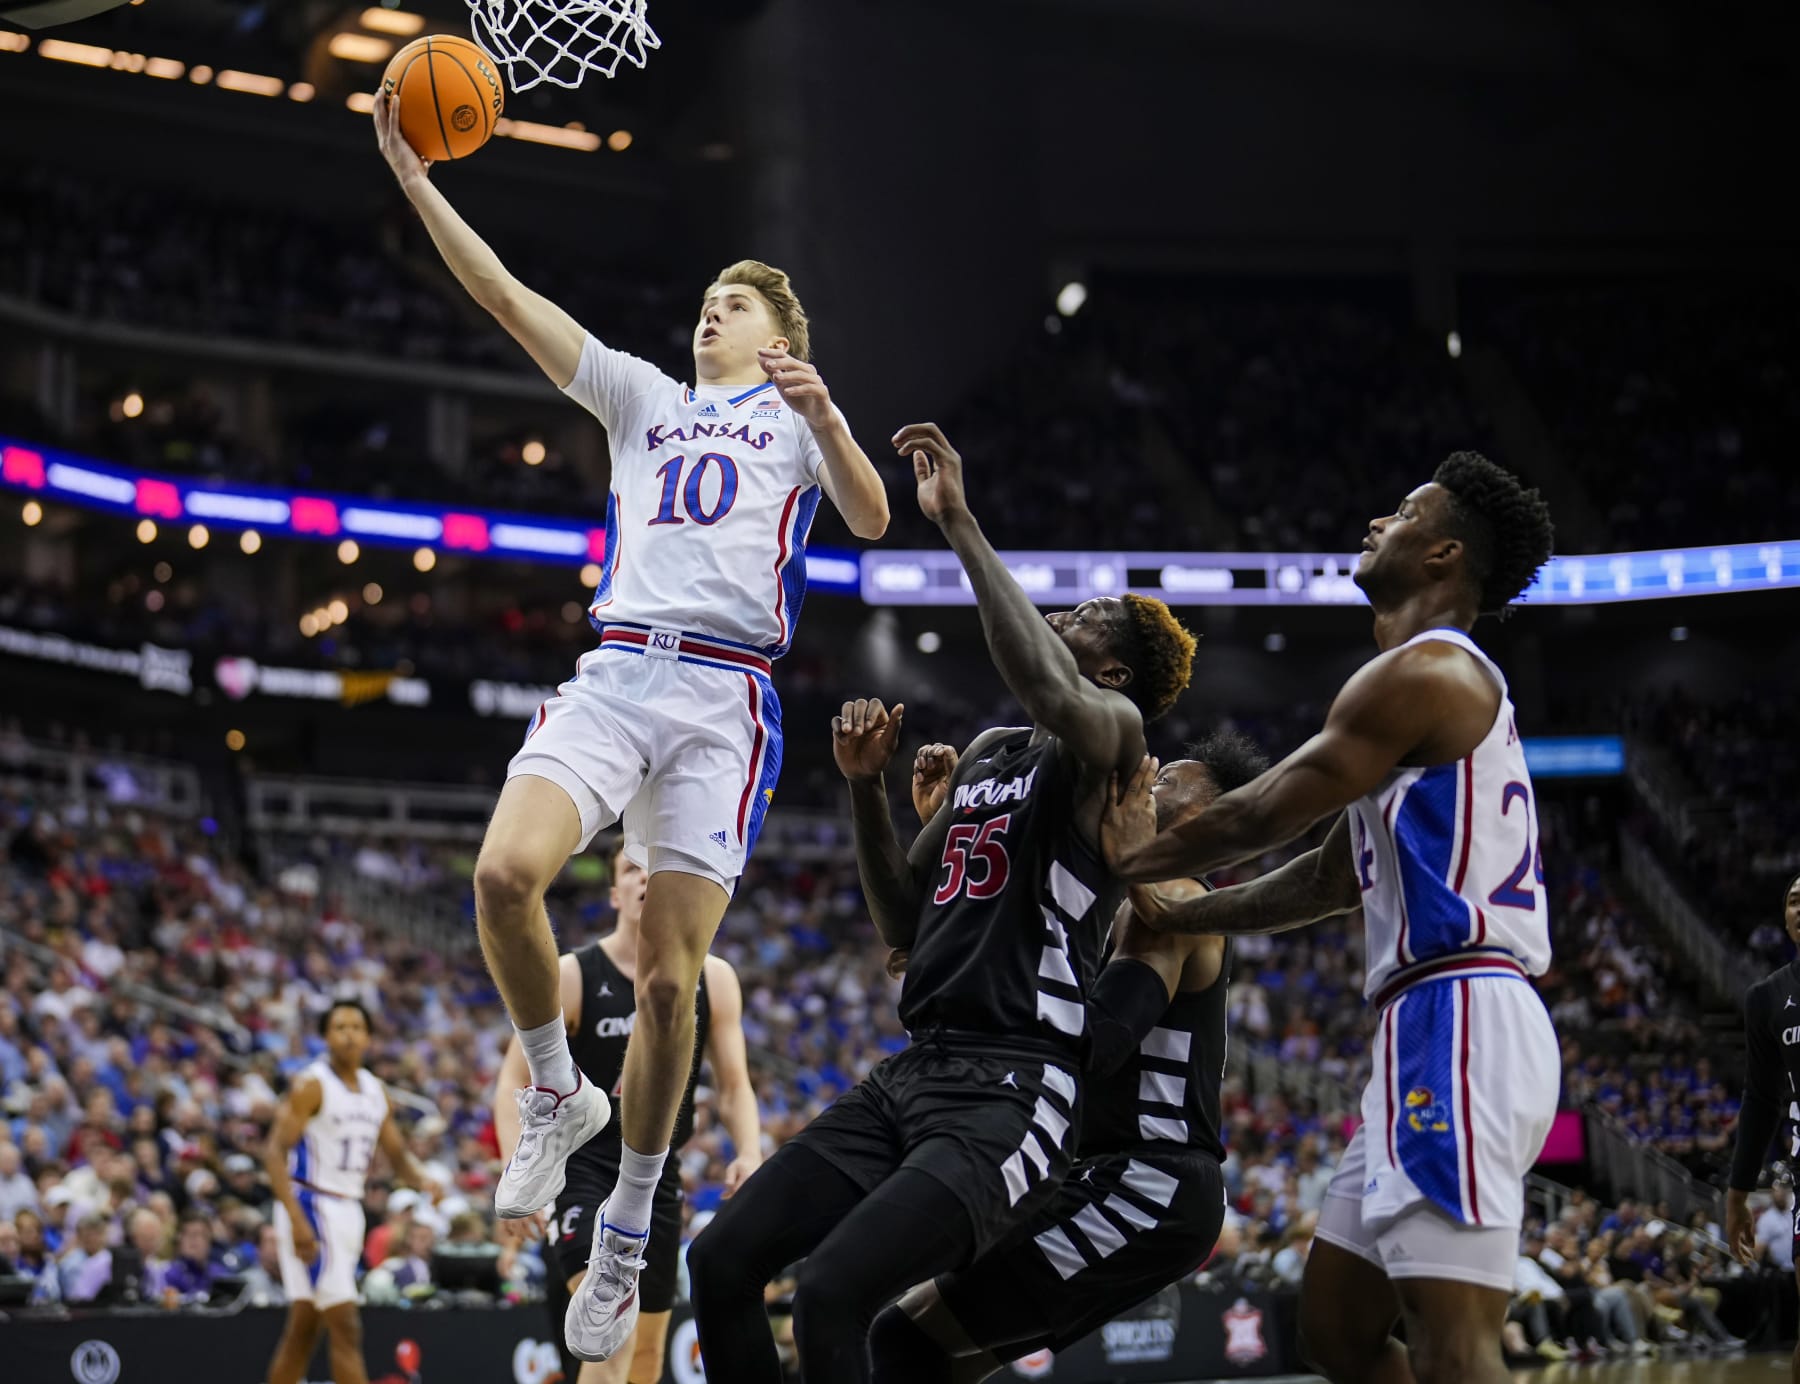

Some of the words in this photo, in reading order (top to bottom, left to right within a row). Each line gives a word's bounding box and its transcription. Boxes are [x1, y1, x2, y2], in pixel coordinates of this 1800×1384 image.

[646, 421, 775, 452] KANSAS
[647, 452, 740, 527] 10
[651, 632, 678, 651] KU
[933, 813, 1011, 905] 55
[336, 1134, 373, 1172] 13
